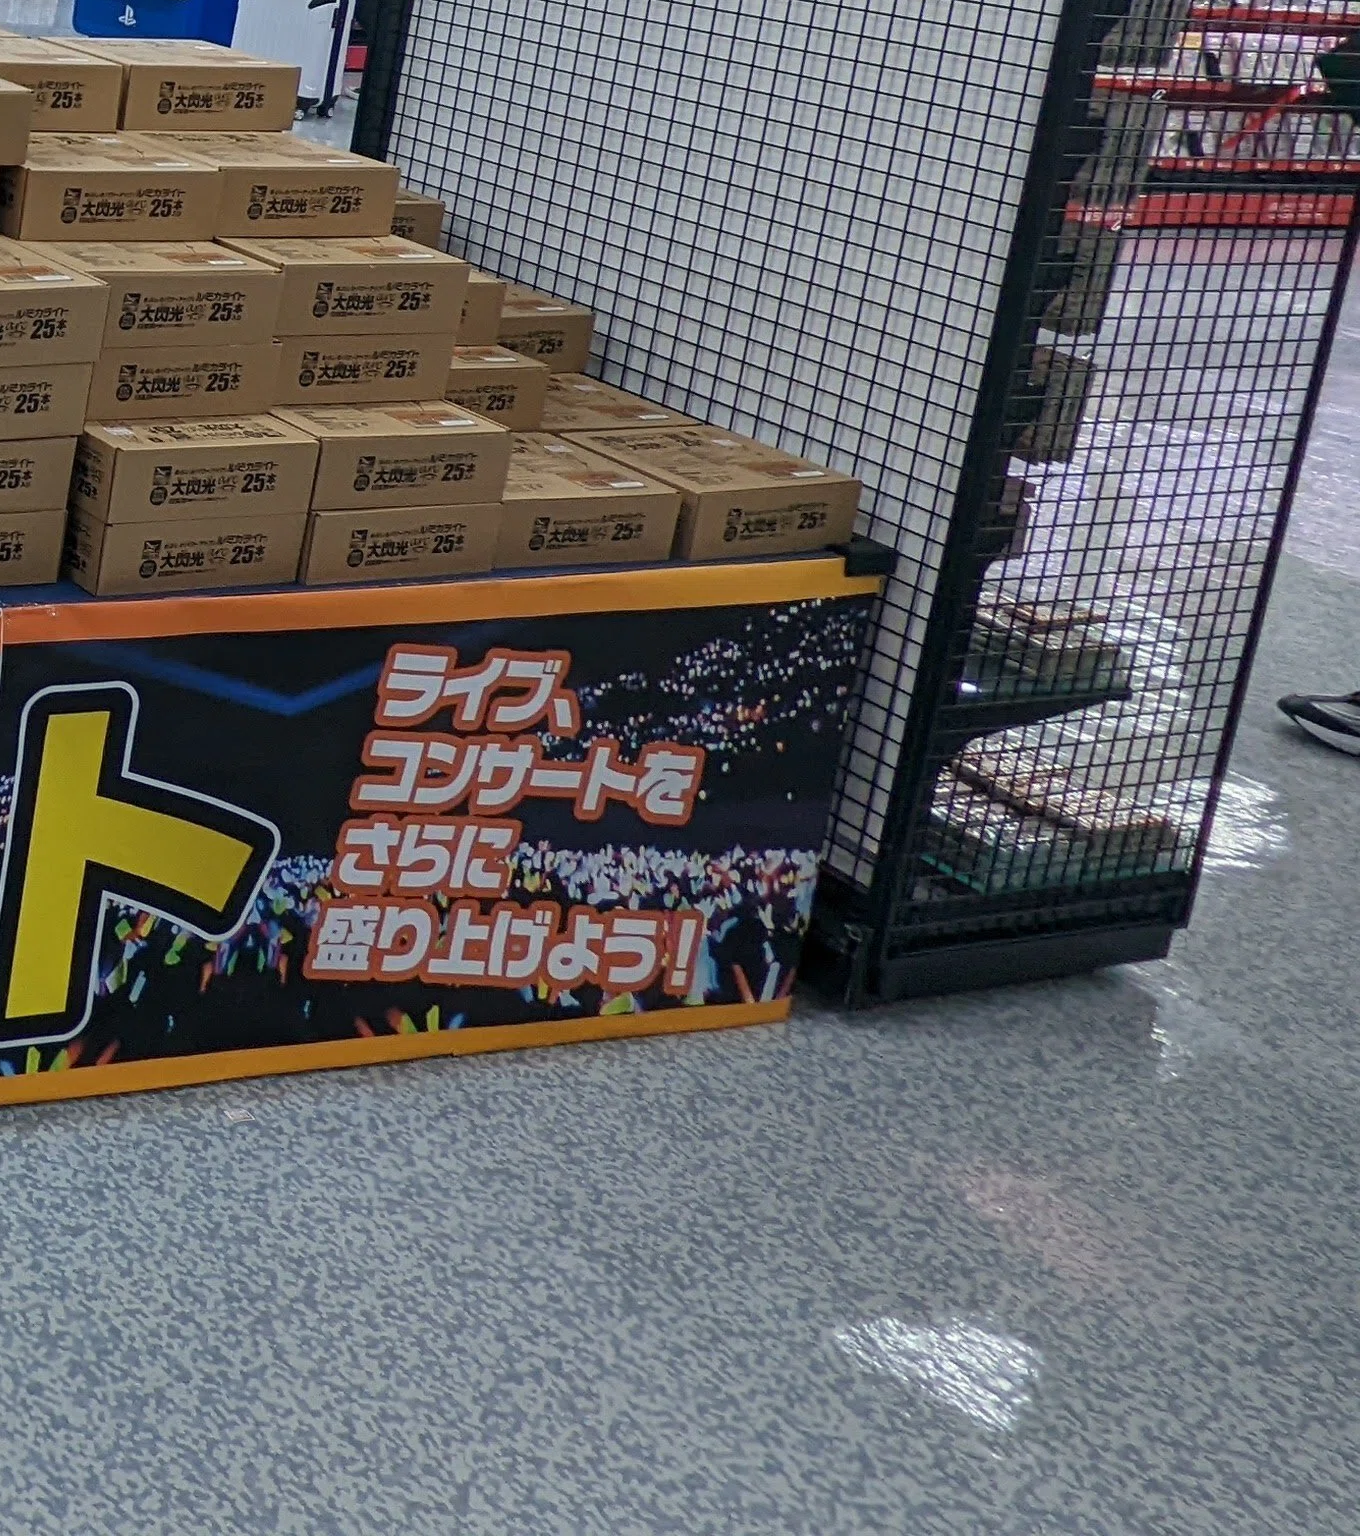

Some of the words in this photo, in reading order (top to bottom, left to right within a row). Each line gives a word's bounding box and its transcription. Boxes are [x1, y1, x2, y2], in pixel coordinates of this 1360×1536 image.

[349, 732, 705, 825] コンサートを
[333, 816, 521, 896] さらに
[304, 899, 708, 994] 盛り上げよう!
